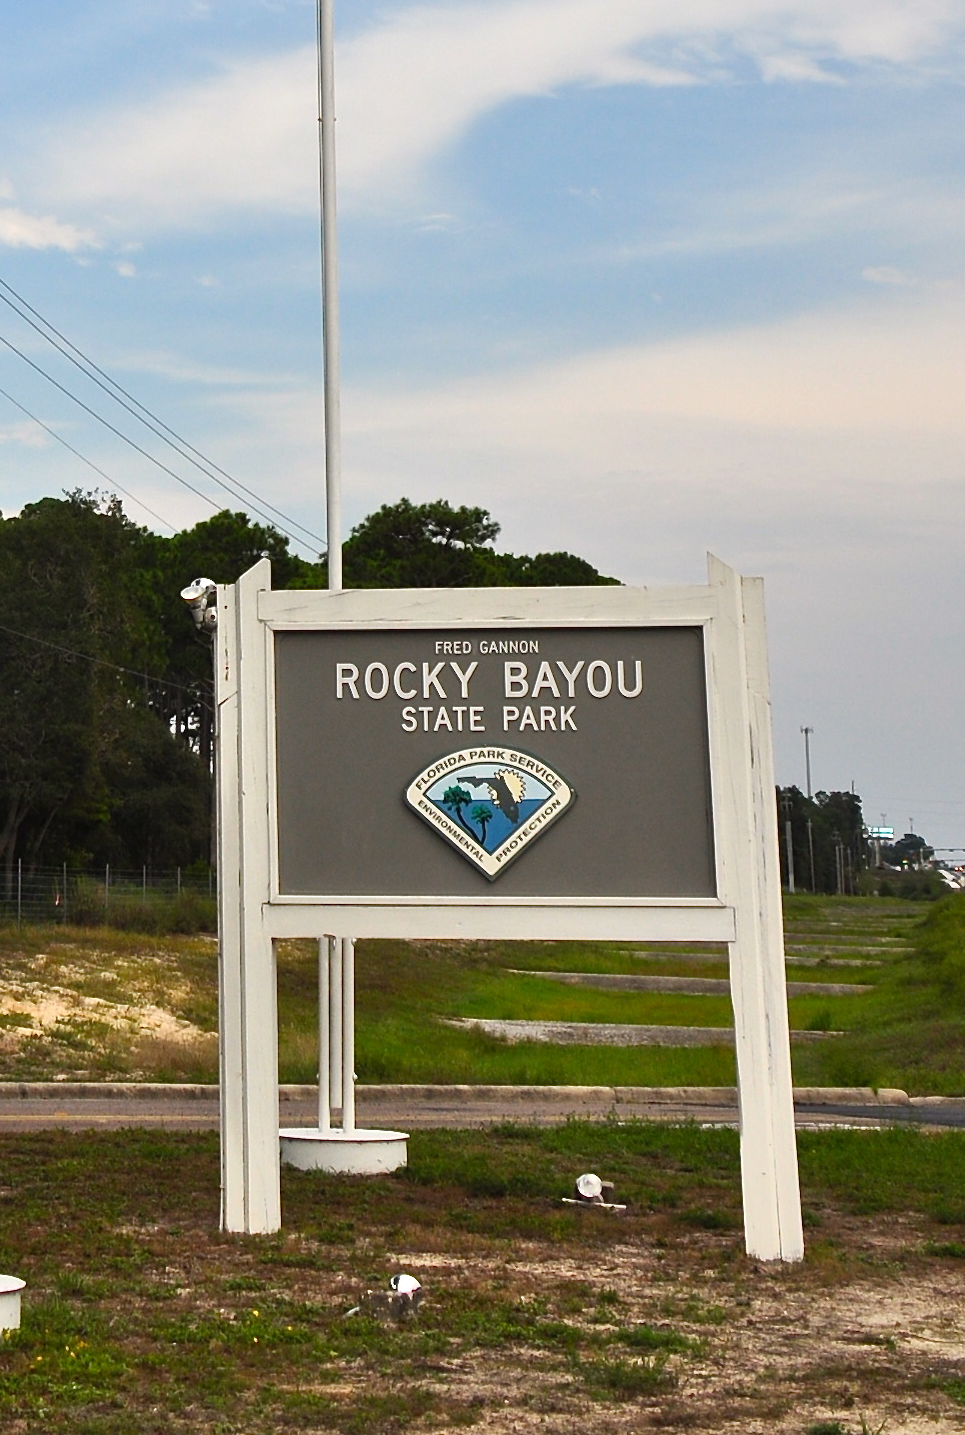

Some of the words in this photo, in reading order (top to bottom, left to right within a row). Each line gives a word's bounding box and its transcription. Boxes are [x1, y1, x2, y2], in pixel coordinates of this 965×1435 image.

[435, 641, 472, 655] FRED
[479, 640, 539, 655] GANNON
[336, 661, 479, 700] ROCKY
[504, 659, 643, 698] BAYOU
[401, 706, 486, 732] STATE
[502, 705, 578, 732] PARK
[415, 754, 466, 790] FLORIDA
[469, 750, 506, 761] PARK
[509, 753, 563, 791] SERVICE
[417, 799, 484, 863] ENVIRONMENTAL
[495, 798, 562, 863] PROTECTION
